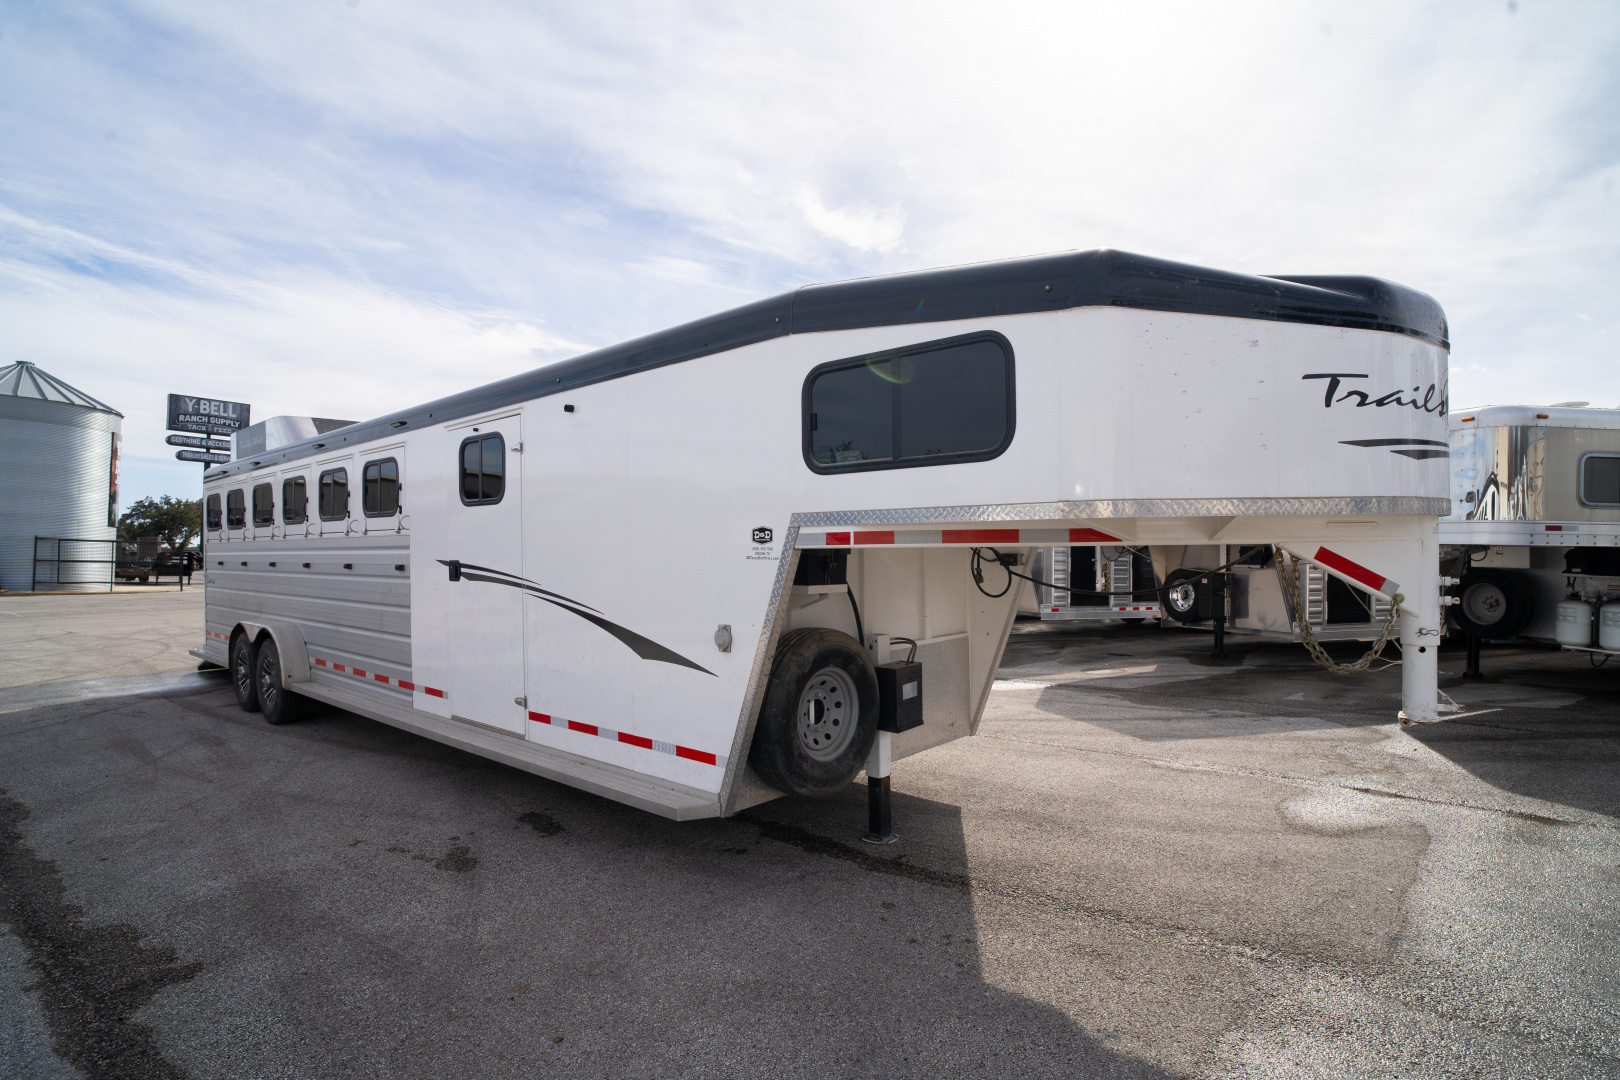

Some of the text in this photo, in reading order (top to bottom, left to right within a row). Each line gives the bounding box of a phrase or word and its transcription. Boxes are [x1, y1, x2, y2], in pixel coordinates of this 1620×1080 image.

[185, 398, 237, 417] Y-BELL
[210, 417, 240, 428] SUPPLY
[171, 436, 201, 445] CLOTHING
[182, 451, 200, 459] TRAILER
